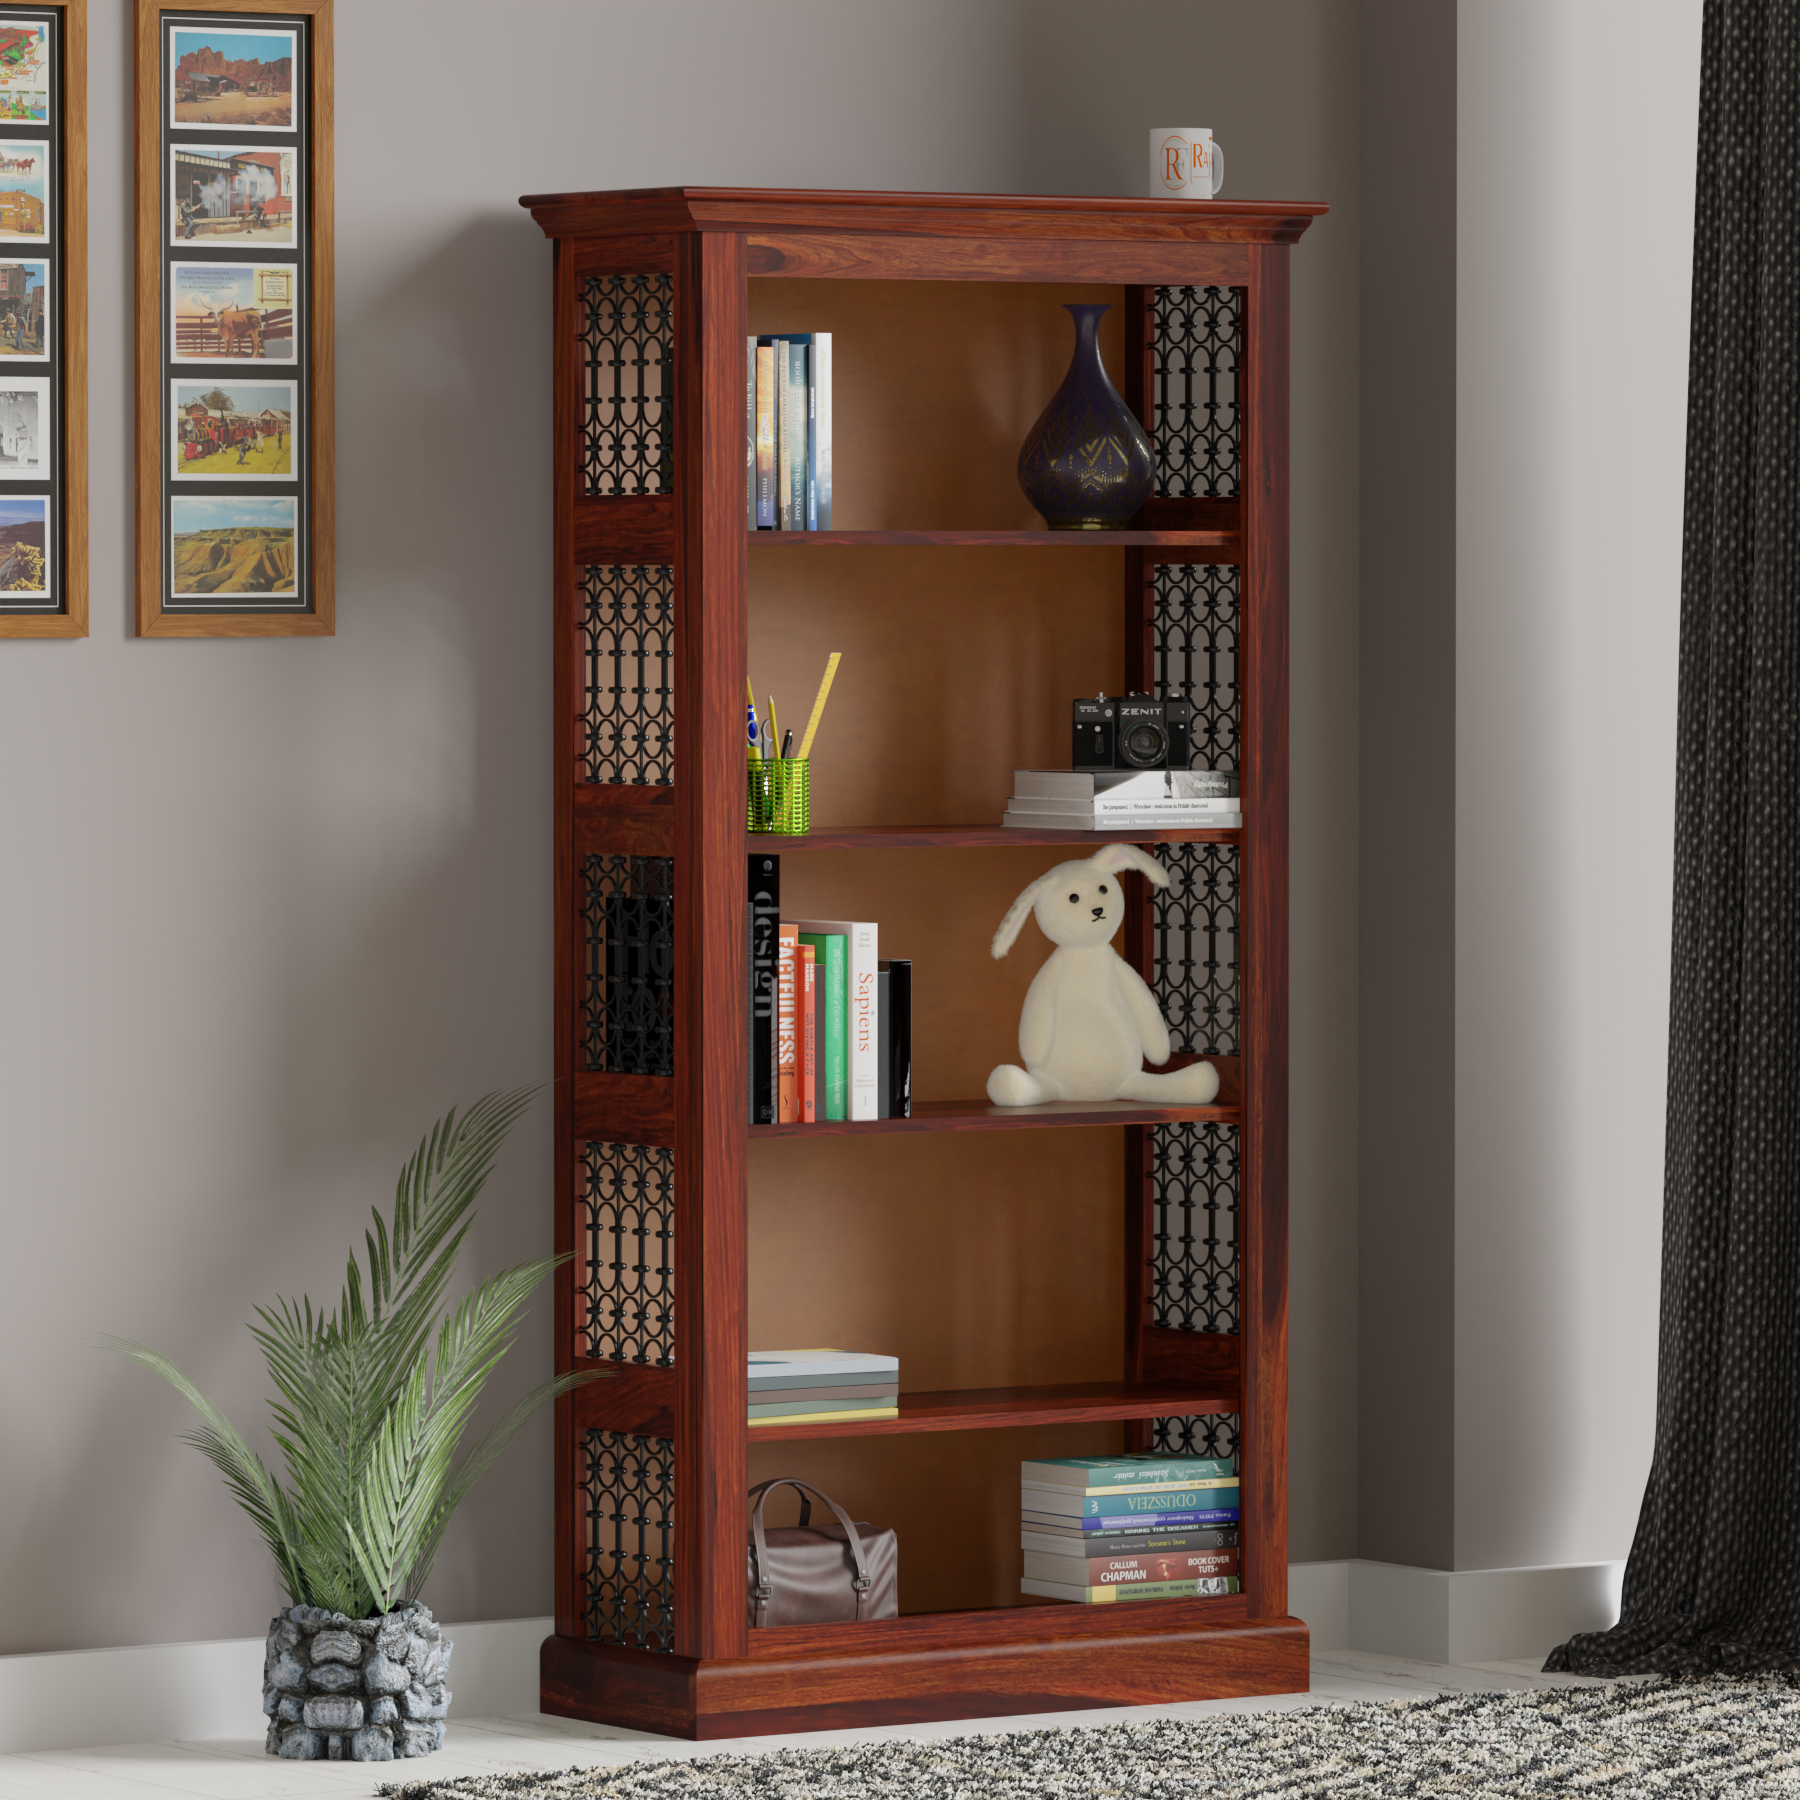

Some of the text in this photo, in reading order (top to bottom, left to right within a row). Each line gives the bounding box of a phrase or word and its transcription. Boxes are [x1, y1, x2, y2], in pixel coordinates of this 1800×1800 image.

[754, 890, 780, 1018] design
[854, 973, 874, 1052] Sapiens
[810, 1068, 814, 1076] OF
[1127, 1494, 1196, 1511] ODÜSSZEIA
[1110, 1560, 1138, 1570] CALLUM
[1188, 1556, 1229, 1566] BOOK COVER
[1198, 1565, 1219, 1573] TUTS+
[1101, 1570, 1146, 1582] CHAPMAN
